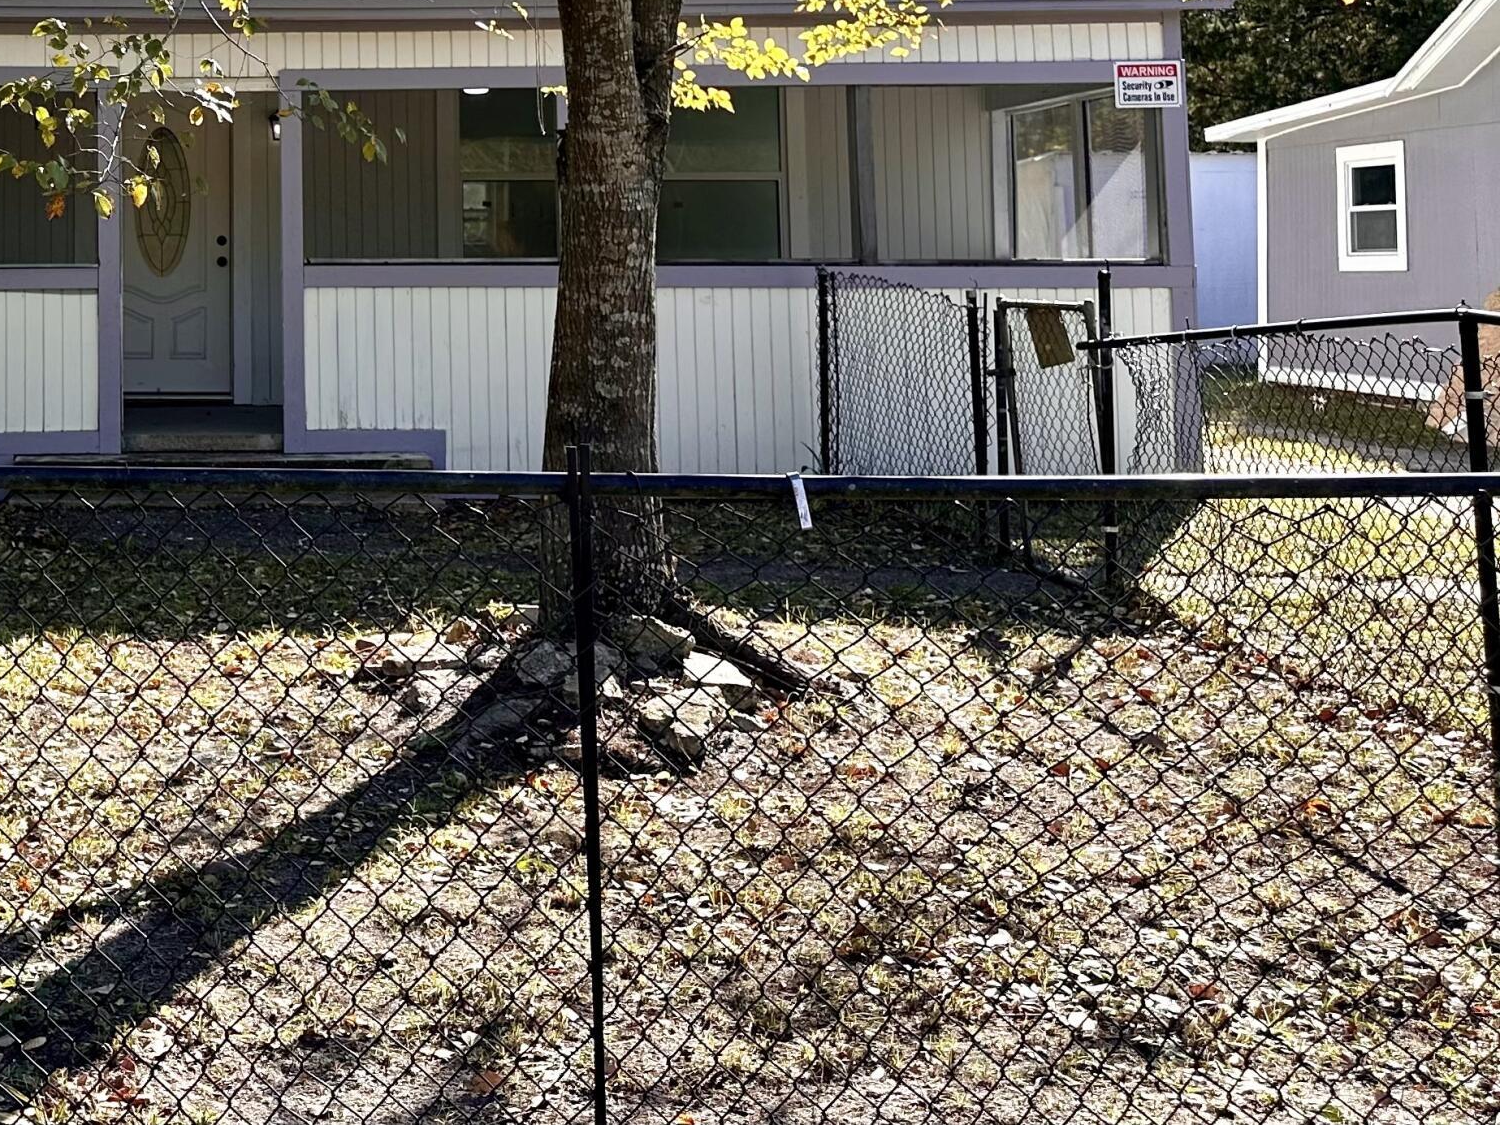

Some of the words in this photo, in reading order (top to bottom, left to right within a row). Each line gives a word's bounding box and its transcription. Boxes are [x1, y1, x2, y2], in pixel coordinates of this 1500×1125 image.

[1120, 66, 1175, 76] WARNING
[1122, 80, 1152, 91] Security
[1122, 92, 1152, 102] Cameras
[1154, 92, 1160, 101] In
[1162, 92, 1175, 101] Use
